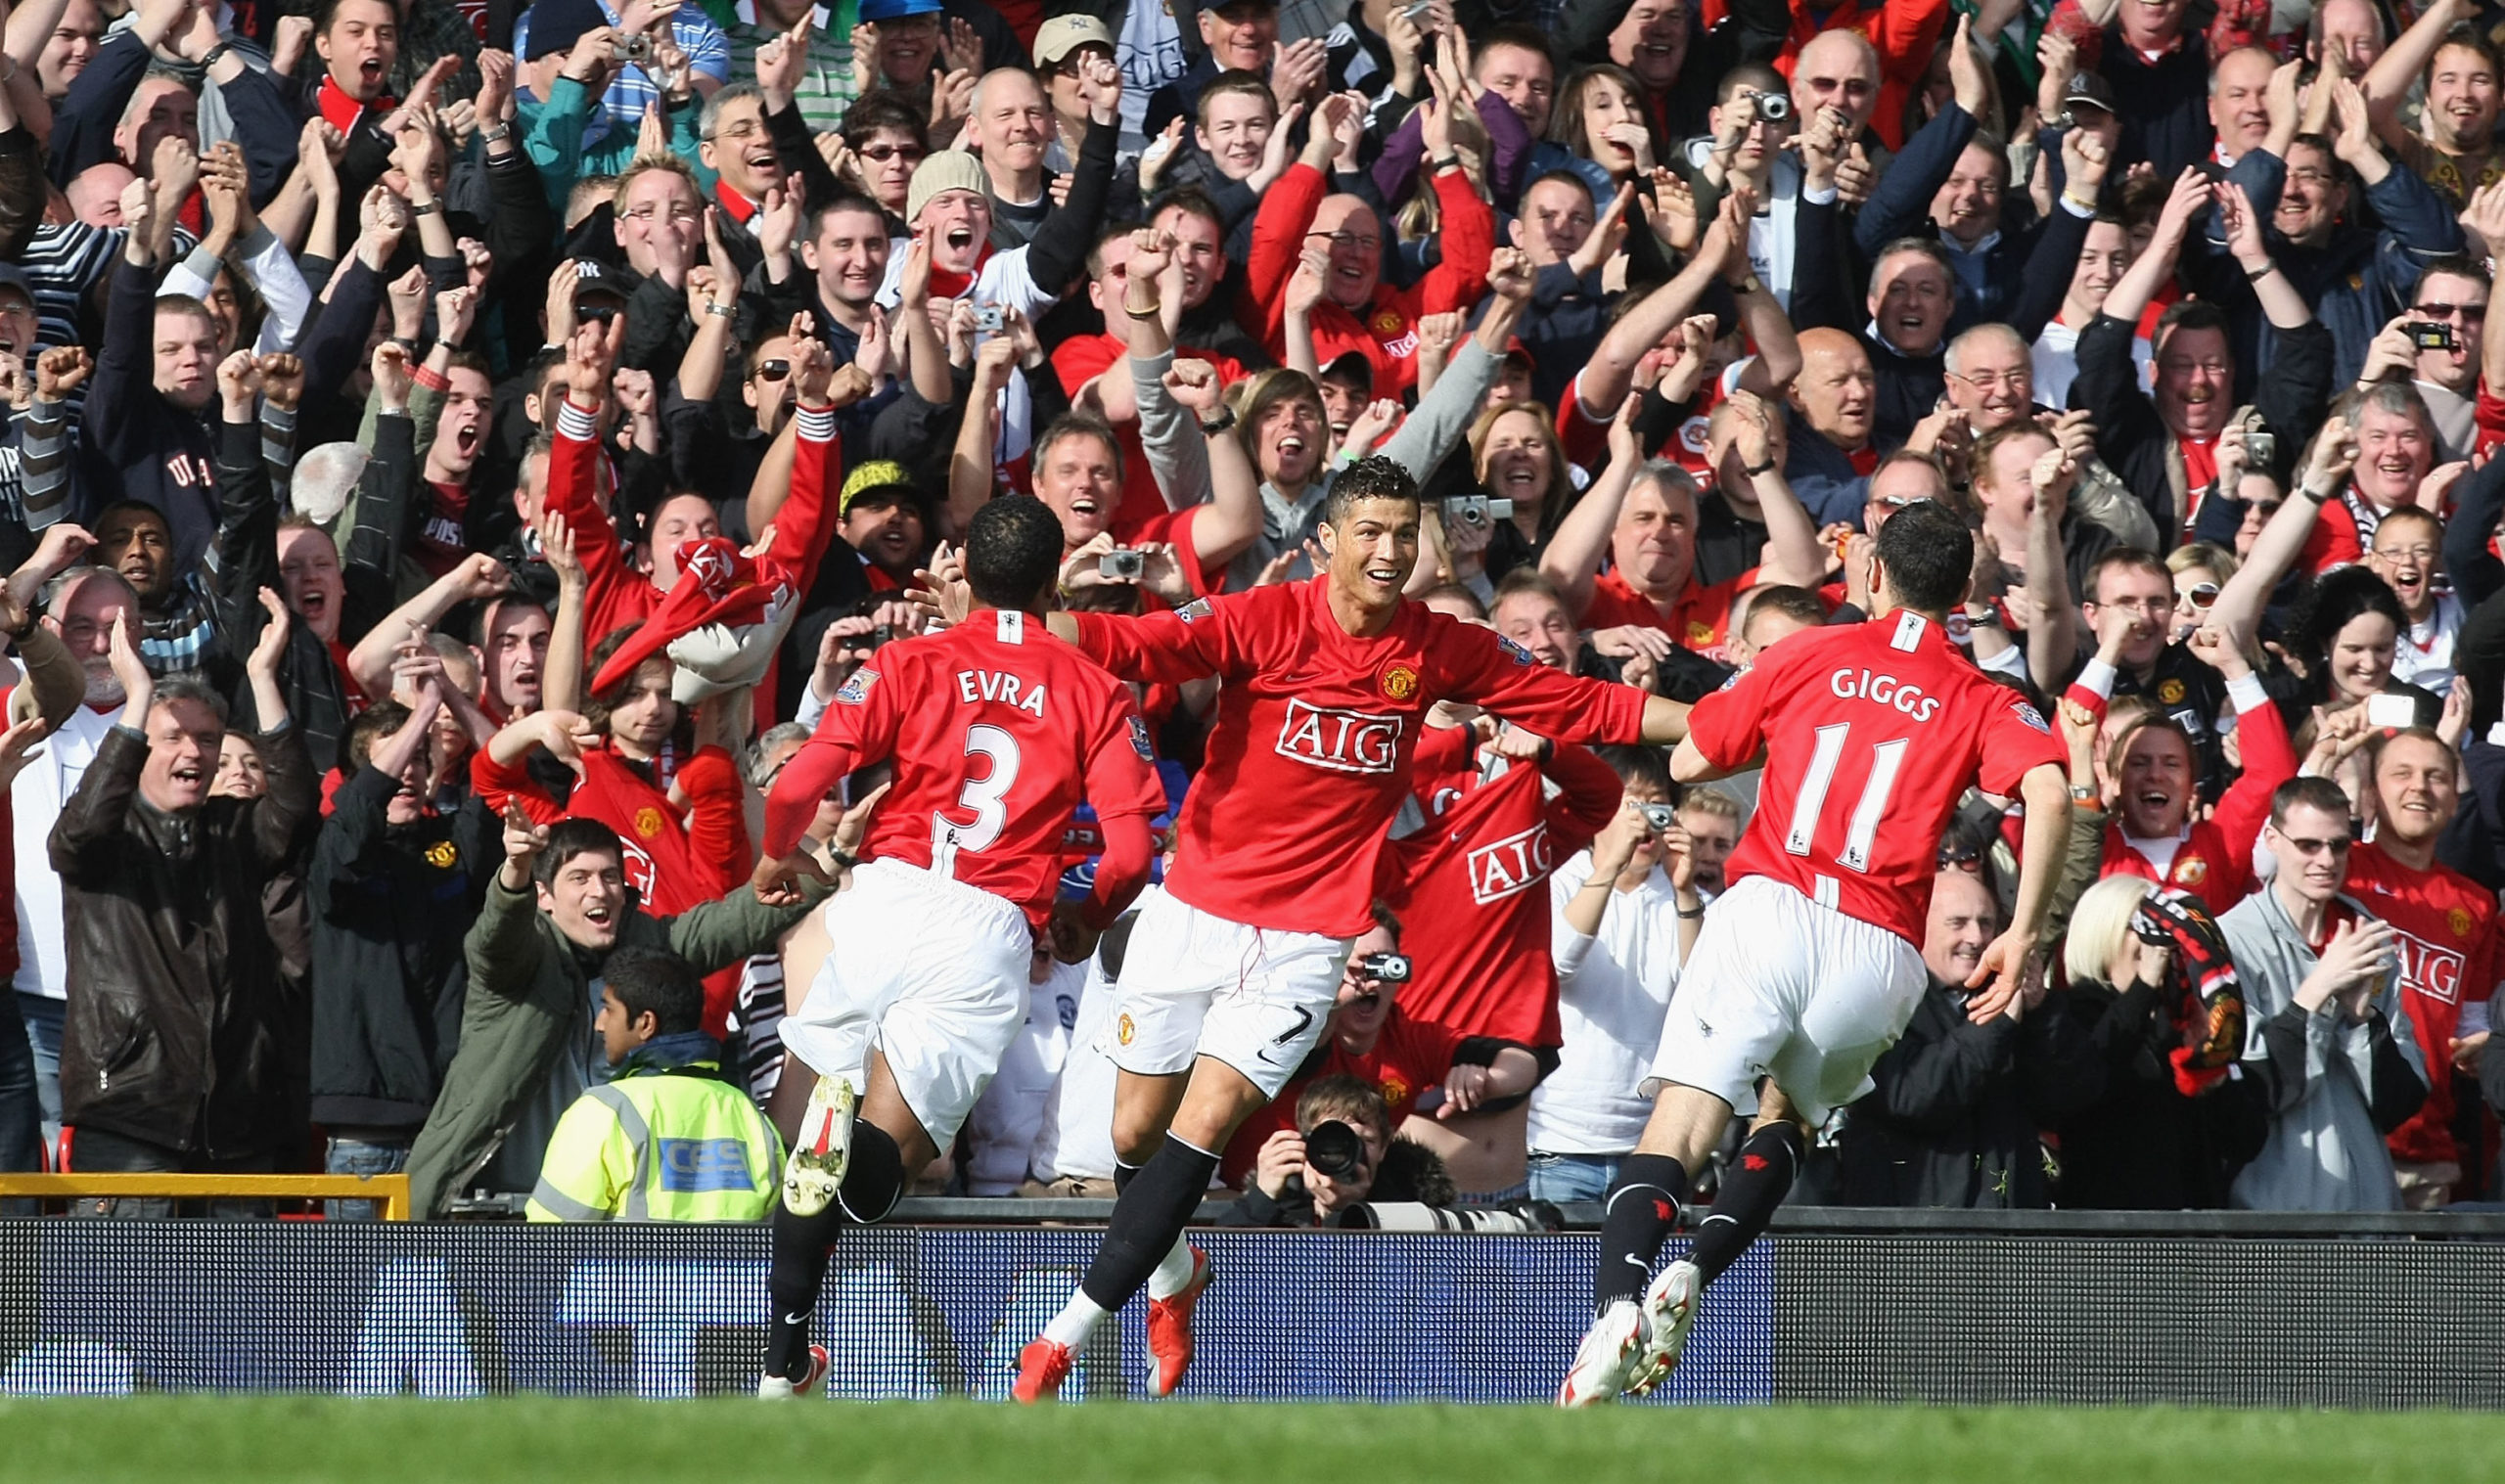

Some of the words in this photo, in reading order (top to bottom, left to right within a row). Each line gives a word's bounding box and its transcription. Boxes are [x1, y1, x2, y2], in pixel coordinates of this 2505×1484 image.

[1120, 47, 1187, 87] AIG
[957, 669, 1046, 718] EVRA
[1831, 668, 1939, 722] GIGGS
[1284, 712, 1393, 766] AIG
[931, 723, 1022, 854] 3
[1785, 722, 1909, 874] 11
[1480, 829, 1552, 895] AIG
[2394, 937, 2458, 996] AIG
[1272, 1005, 1313, 1046] 7
